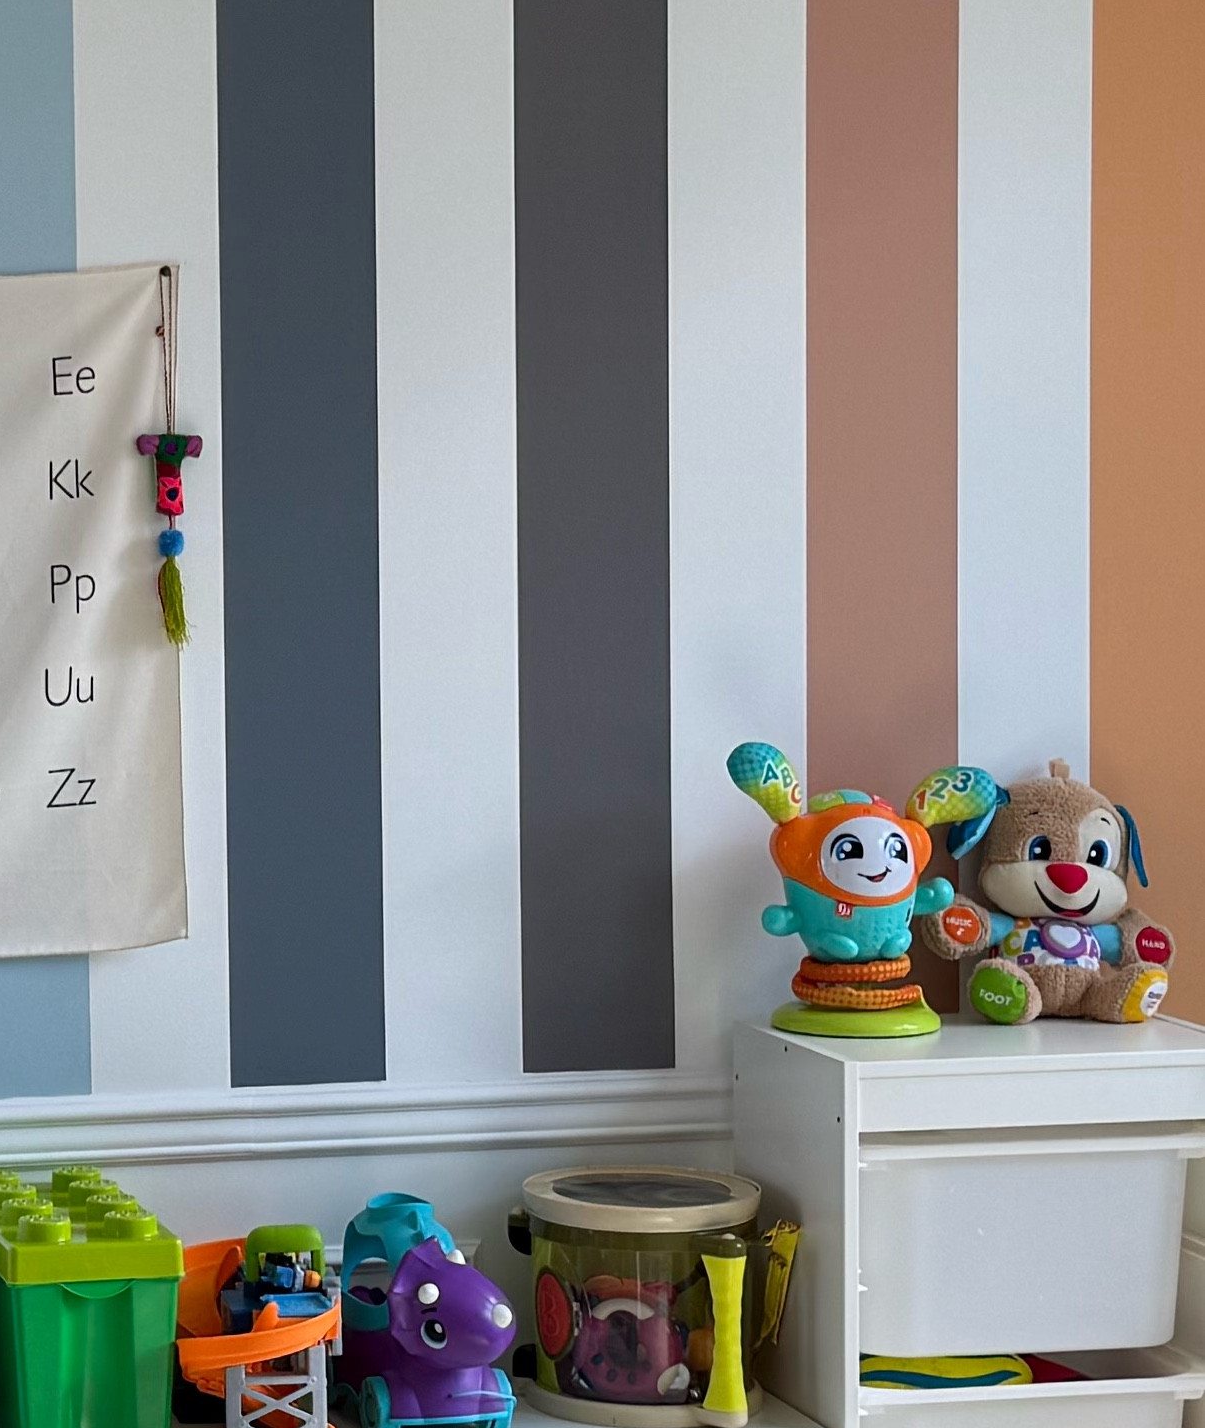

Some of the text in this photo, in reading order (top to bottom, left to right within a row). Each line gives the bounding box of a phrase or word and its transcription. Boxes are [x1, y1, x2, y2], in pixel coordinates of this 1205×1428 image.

[51, 355, 96, 397] Ee
[48, 457, 95, 501] Kk
[50, 563, 96, 615] Pp
[44, 665, 94, 708] Uu
[45, 767, 97, 809] Zz
[979, 988, 1013, 1006] FOOT
